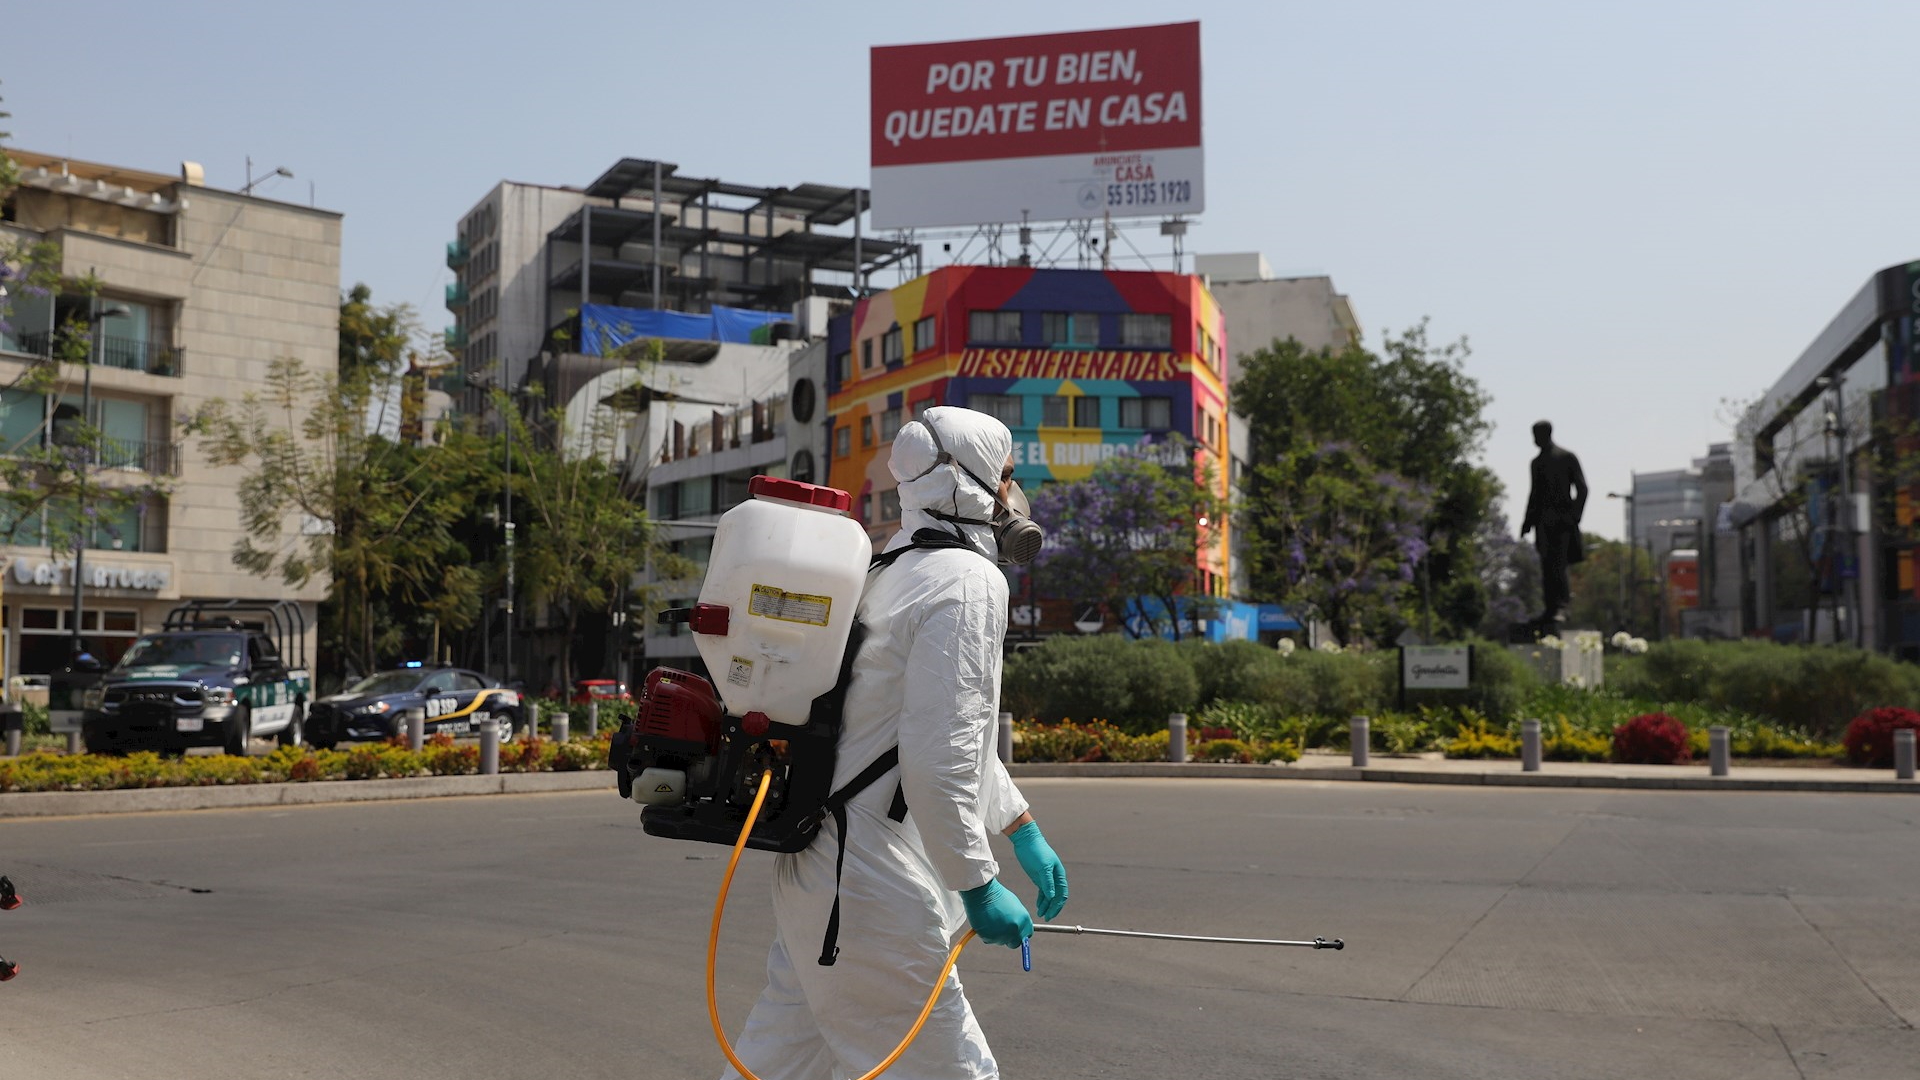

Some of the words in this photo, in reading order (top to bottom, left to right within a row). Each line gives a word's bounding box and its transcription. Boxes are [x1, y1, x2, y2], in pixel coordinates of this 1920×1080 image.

[926, 60, 995, 94] POR
[1003, 55, 1048, 89] TU
[1055, 49, 1143, 85] BIEN,
[884, 101, 1038, 147] QUEDATE
[1044, 97, 1092, 131] EN
[1098, 91, 1188, 127] CASA
[1115, 163, 1155, 182] CASA
[1108, 184, 1122, 205] 55
[1126, 182, 1157, 204] 5135
[1161, 179, 1191, 203] 1920
[956, 349, 1182, 380] DESENFRENADAS
[1028, 442, 1048, 464] EL
